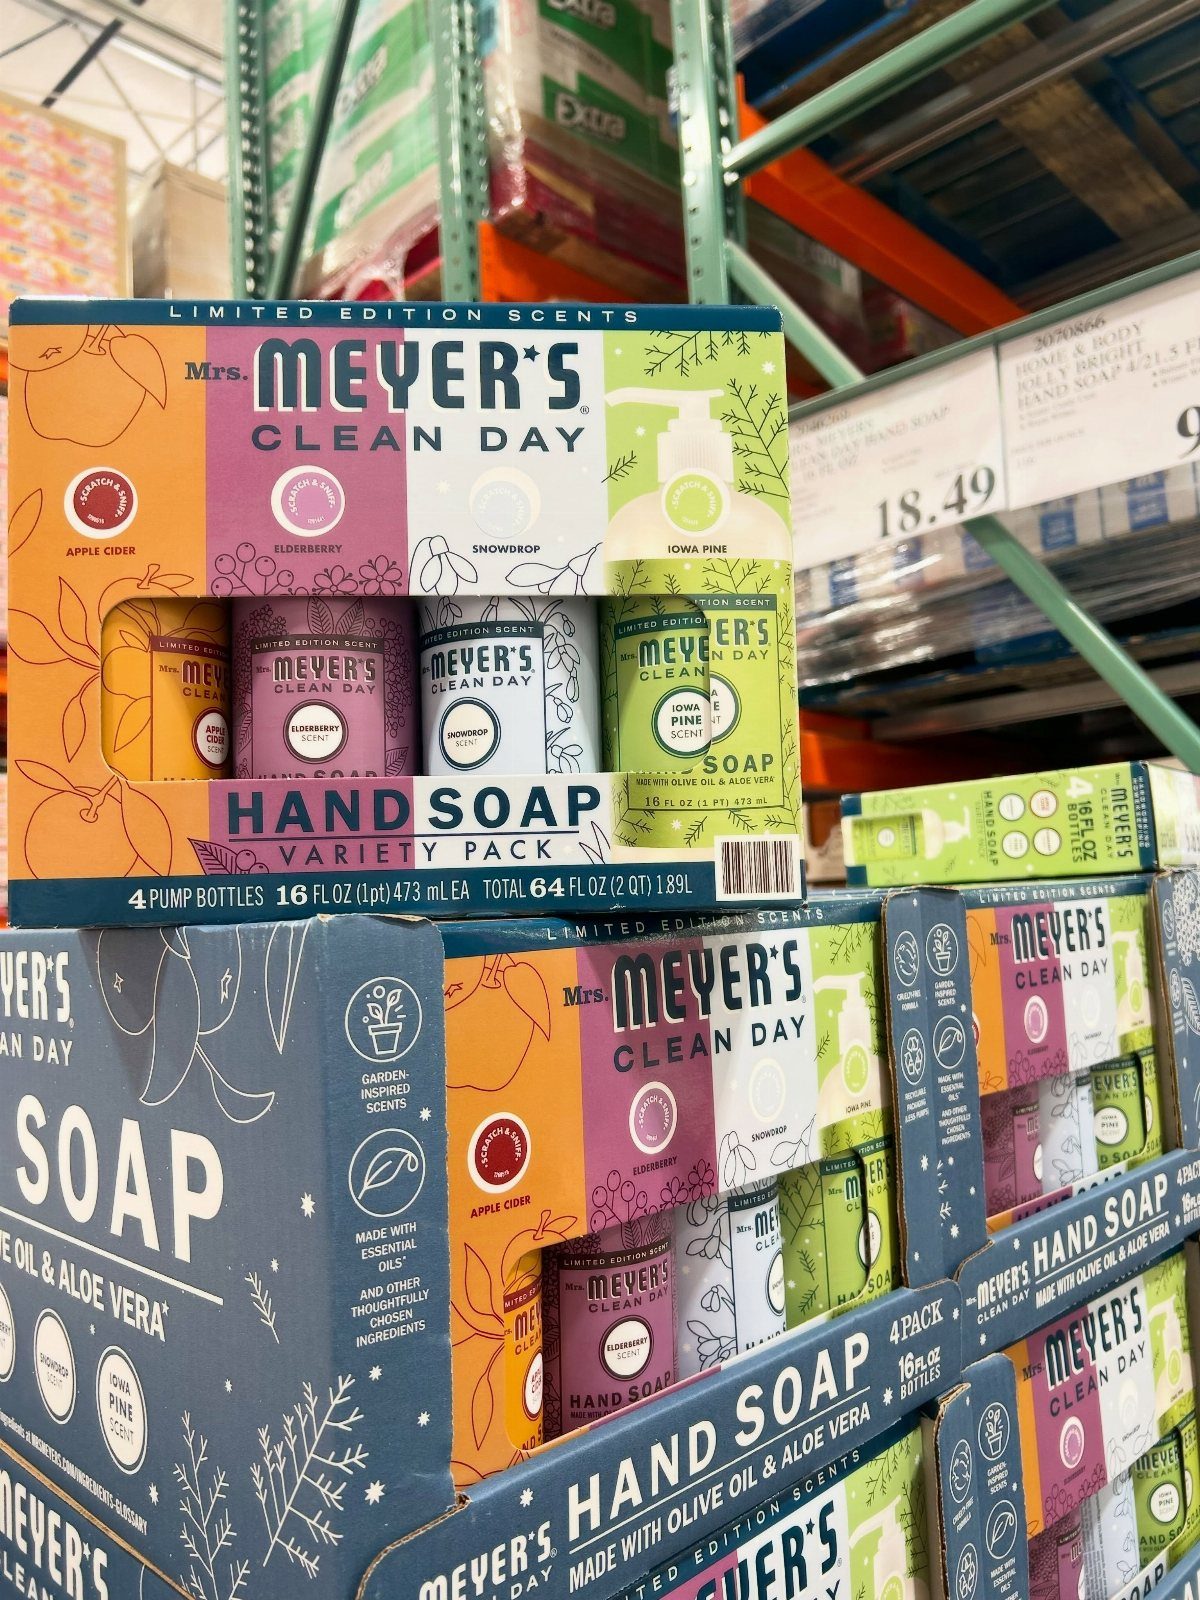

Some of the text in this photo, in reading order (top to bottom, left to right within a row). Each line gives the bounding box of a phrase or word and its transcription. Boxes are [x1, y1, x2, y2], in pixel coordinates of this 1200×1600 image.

[169, 305, 638, 323] LIMITED EDITION SCENTS
[184, 337, 582, 414] Mrs. MEYER'S
[250, 424, 586, 453] CLEAN DAY
[80, 477, 128, 517] SCRATCH & SNIFF
[877, 464, 996, 538] 18.49
[66, 546, 136, 557] APPLE CIDER
[274, 544, 343, 554] ELDERBERRY
[472, 544, 541, 554] SNOWDROP
[668, 544, 728, 554] IOWA PINE
[254, 639, 378, 650] LIMITED EDITION SCENT
[733, 649, 769, 660] DAY
[255, 655, 377, 683] Mrs. MEYER'S
[430, 644, 533, 680] MEYER'S
[639, 666, 705, 682] CLEAN
[274, 683, 377, 695] CLEAN DAY
[431, 674, 533, 695] CLEAN DAY
[671, 715, 702, 726] PINE
[672, 703, 700, 712] IOWA
[290, 724, 340, 733] ELDERBERRY
[301, 733, 329, 743] SCENT
[446, 728, 489, 740] SNOWDROP
[671, 728, 703, 739] SCENT
[702, 753, 774, 775] SOAP
[652, 778, 669, 787] WITH
[671, 778, 697, 787] OLIVE
[700, 778, 716, 786] OIL
[718, 778, 726, 786] &
[729, 777, 750, 785] ALOE
[1066, 775, 1095, 798] 4
[227, 784, 601, 835] HAND SOAP
[645, 796, 660, 807] 16
[664, 799, 675, 807] FL
[679, 799, 692, 807] OZ
[713, 798, 729, 807] PT)
[734, 797, 752, 806] 473
[983, 790, 999, 866] HAND SOAP
[1067, 803, 1083, 864] BOTTLES
[1078, 800, 1098, 862] 16 FL OZ
[279, 838, 552, 866] VARIETY PACK
[128, 887, 147, 910] 4
[149, 887, 193, 909] PUMP
[196, 885, 264, 908] BOTTLES
[276, 883, 308, 906] 16
[313, 883, 330, 905] FL
[332, 882, 352, 904] OZ
[356, 881, 390, 907] (1pt)
[393, 881, 420, 902] 473
[426, 880, 449, 902] mL
[451, 880, 470, 900] EA
[483, 878, 527, 899] TOTAL
[529, 877, 565, 899] 64
[569, 876, 586, 898] FL
[588, 876, 607, 897] OZ
[610, 875, 625, 899] (2
[628, 874, 652, 898] QT)
[979, 884, 1116, 904] LIMITED EDITION SCENTS
[547, 908, 825, 940] LIMITED EDITION SCENTS
[990, 906, 1106, 965] Mrs. MEYER'S
[563, 939, 802, 1033] Mrs. MEYER'S
[1015, 958, 1108, 990] CLEAN DAY
[33, 1034, 74, 1067] DAY
[613, 1014, 806, 1073] CLEAN DAY
[361, 1069, 410, 1085] GARDEN-
[360, 1083, 411, 1100] INSPIRED
[366, 1098, 407, 1114] SCENTS
[751, 1125, 788, 1142] SNOWDROP
[16, 1094, 224, 1264] SOAP
[633, 1155, 678, 1176] ELDERBERRY
[470, 1195, 532, 1219] APPLE CIDER
[355, 1221, 417, 1245] MADE WITH
[1032, 1172, 1168, 1278] HAND SOAP
[361, 1238, 418, 1260] ESSENTIAL
[14, 1237, 39, 1278] OIL
[41, 1250, 55, 1286] &
[58, 1259, 105, 1312] ALOE
[1035, 1221, 1170, 1310] MADE WITH OLIVE OIL & ALOE VERA
[360, 1276, 421, 1301] AND OTHER
[977, 1260, 1029, 1310] MEYER'S
[351, 1288, 430, 1318] THOUGHTFULLY
[369, 1308, 413, 1329] CHOSEN
[356, 1319, 426, 1348] INGREDIENTS
[1045, 1286, 1143, 1392] MEYER'S
[109, 1372, 131, 1396] IOWA
[900, 1363, 941, 1400] BOTTLES
[1049, 1341, 1146, 1418] CLEAN DAY
[109, 1392, 133, 1423] PINE
[109, 1416, 135, 1446] SCENT
[568, 1331, 871, 1542] HAND SOAP
[569, 1401, 871, 1594] MADE WITH OLIVE OIL & ALOE VERA
[694, 1449, 860, 1565] EDITION SCENTS
